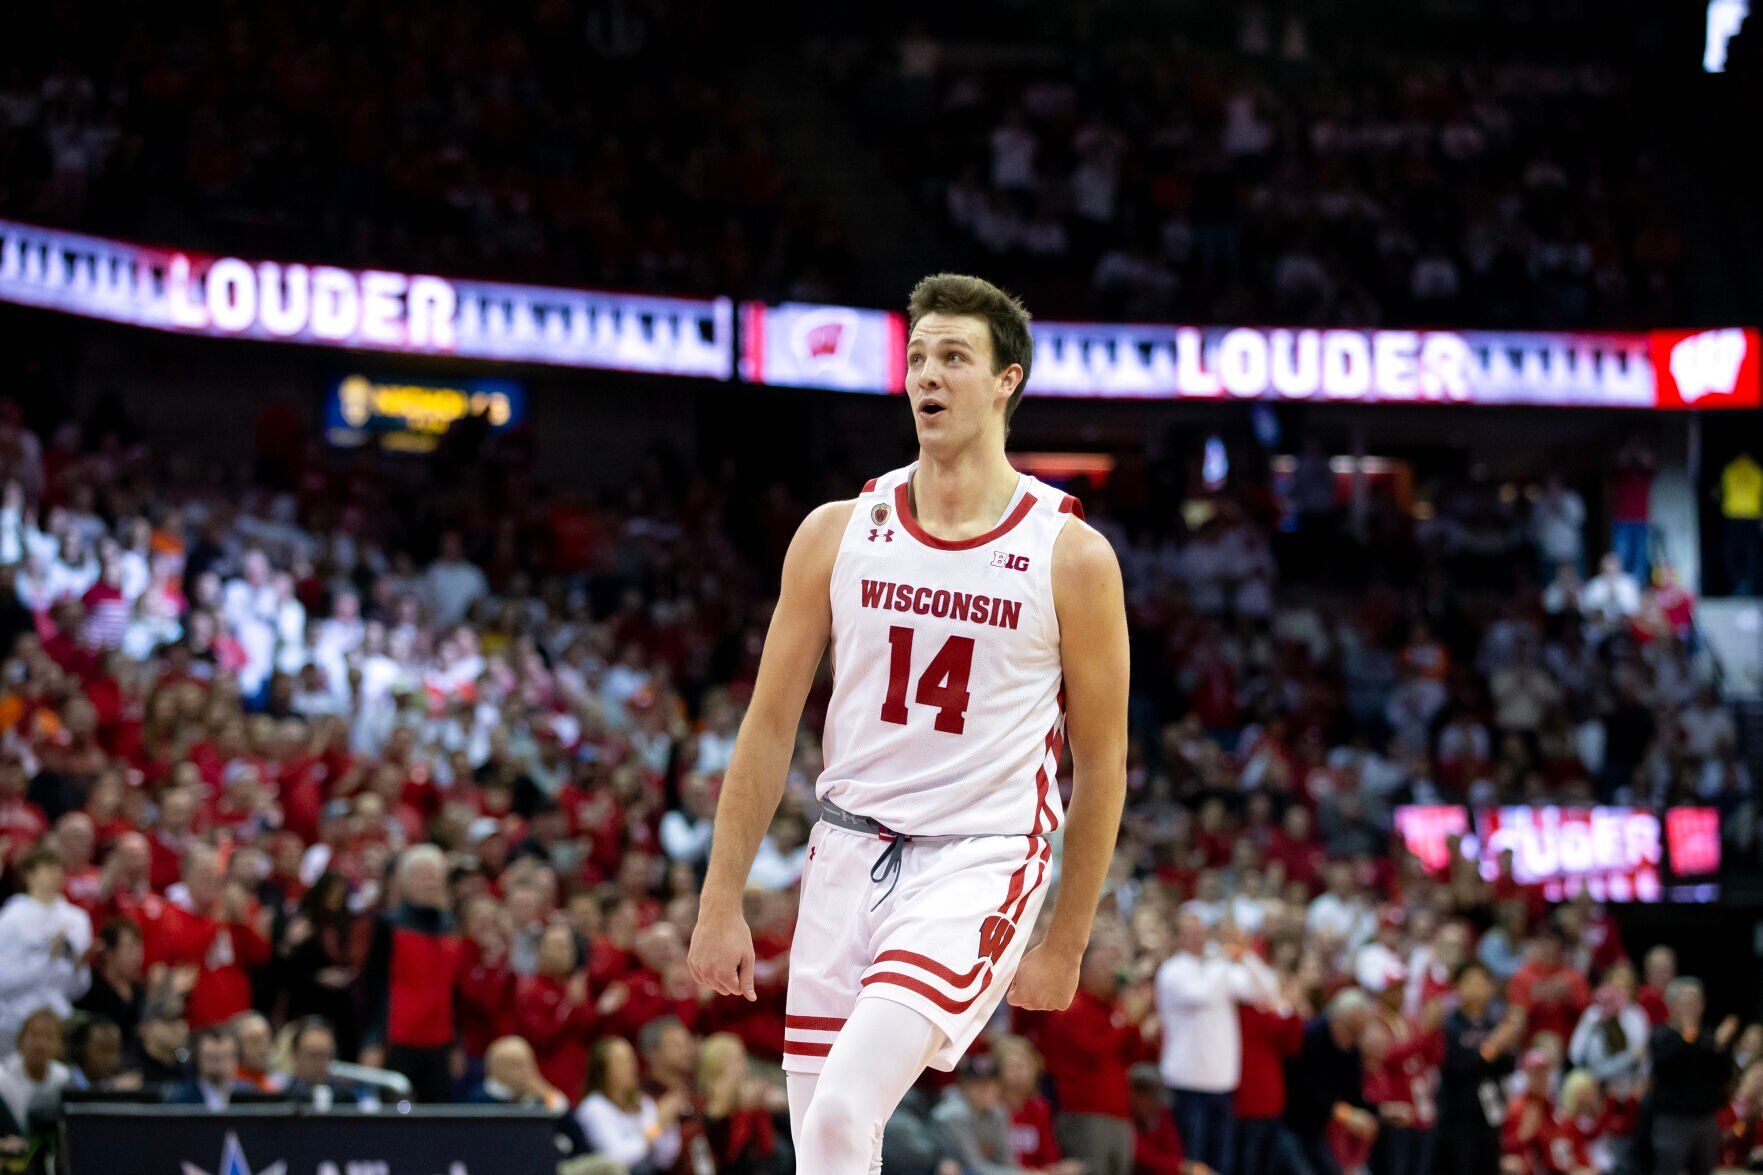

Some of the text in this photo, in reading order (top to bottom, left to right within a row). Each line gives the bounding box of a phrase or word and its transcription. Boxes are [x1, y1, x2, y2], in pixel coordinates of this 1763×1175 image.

[169, 252, 458, 348] LOUDER
[1175, 326, 1471, 400] LOUDER
[861, 579, 1022, 630] WISCONSIN
[880, 625, 975, 735] 14
